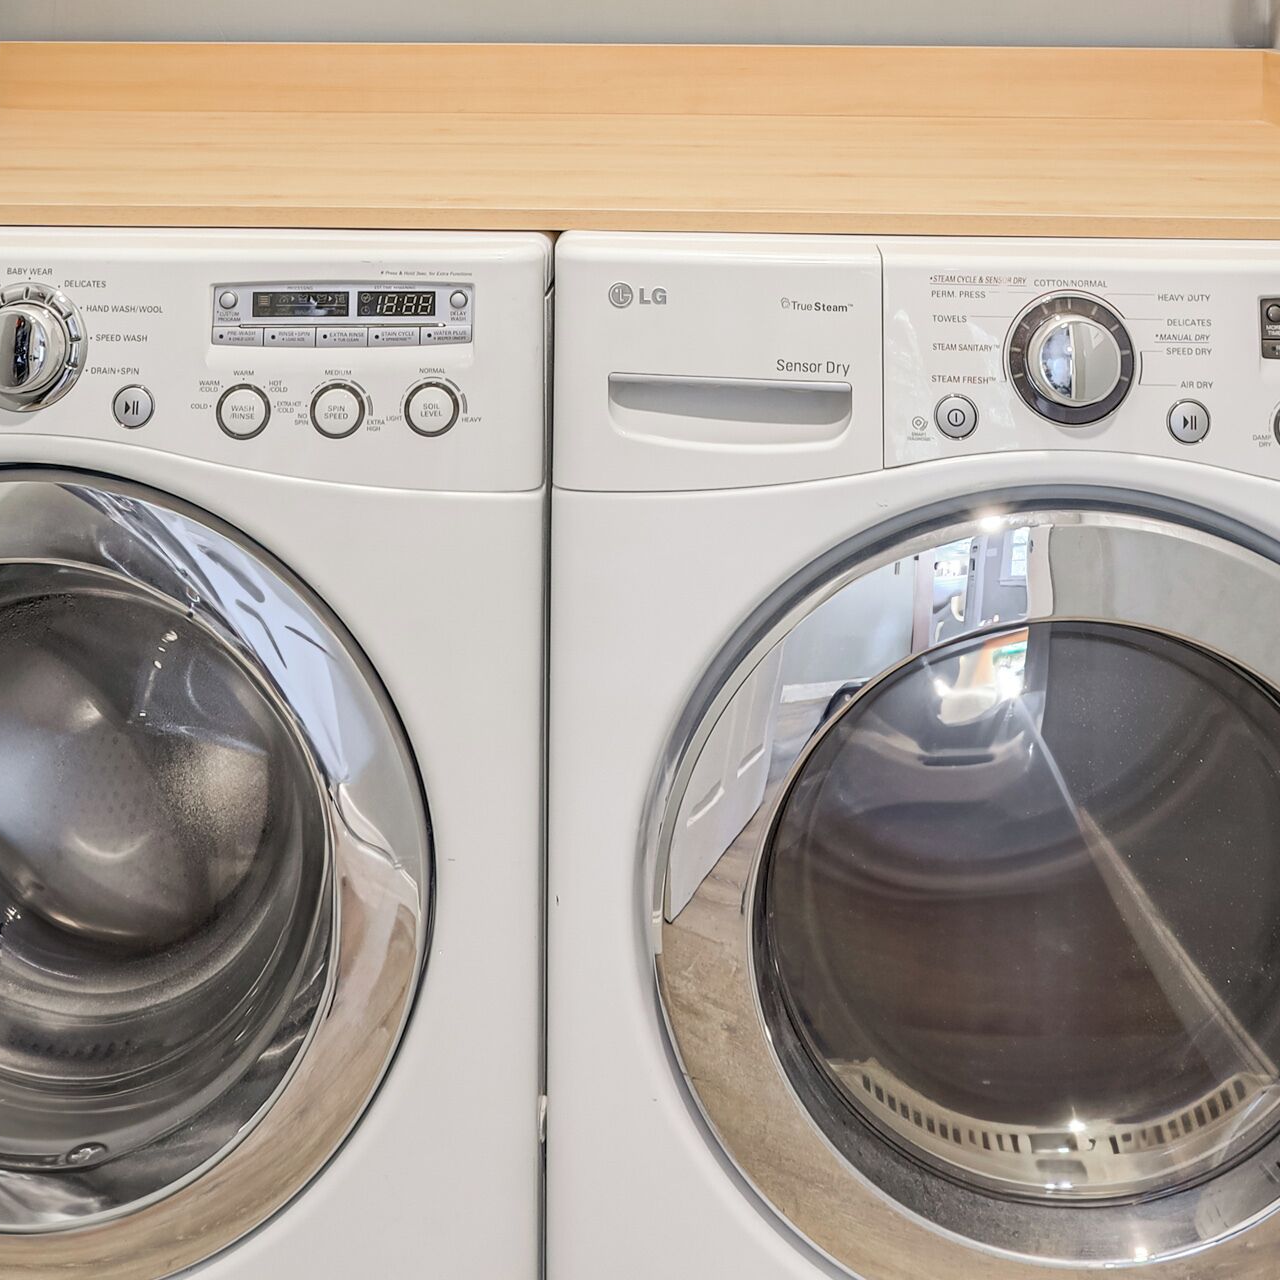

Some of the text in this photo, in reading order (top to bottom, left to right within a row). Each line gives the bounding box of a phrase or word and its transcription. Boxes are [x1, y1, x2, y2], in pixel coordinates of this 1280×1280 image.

[7, 267, 53, 276] BABY WEAR
[64, 280, 106, 288] DELICATES
[1034, 279, 1108, 288] COTTON/NORMAL
[639, 288, 667, 305] LG
[931, 290, 957, 298] PERM.
[1158, 294, 1211, 302] HEAVY DUTY
[86, 305, 163, 313] HAND WASH/WOOL
[791, 301, 813, 311] True
[932, 314, 967, 323] TOWELS
[1167, 319, 1212, 327] DELICATES
[95, 334, 148, 342] SPEED WASH
[1194, 333, 1210, 341] DRY
[932, 343, 957, 351] STEAM
[1166, 348, 1212, 356] SPEED DRY
[776, 359, 850, 377] Sensor Dry
[931, 375, 960, 383] STEAM
[1180, 381, 1213, 389] AIR DRY
